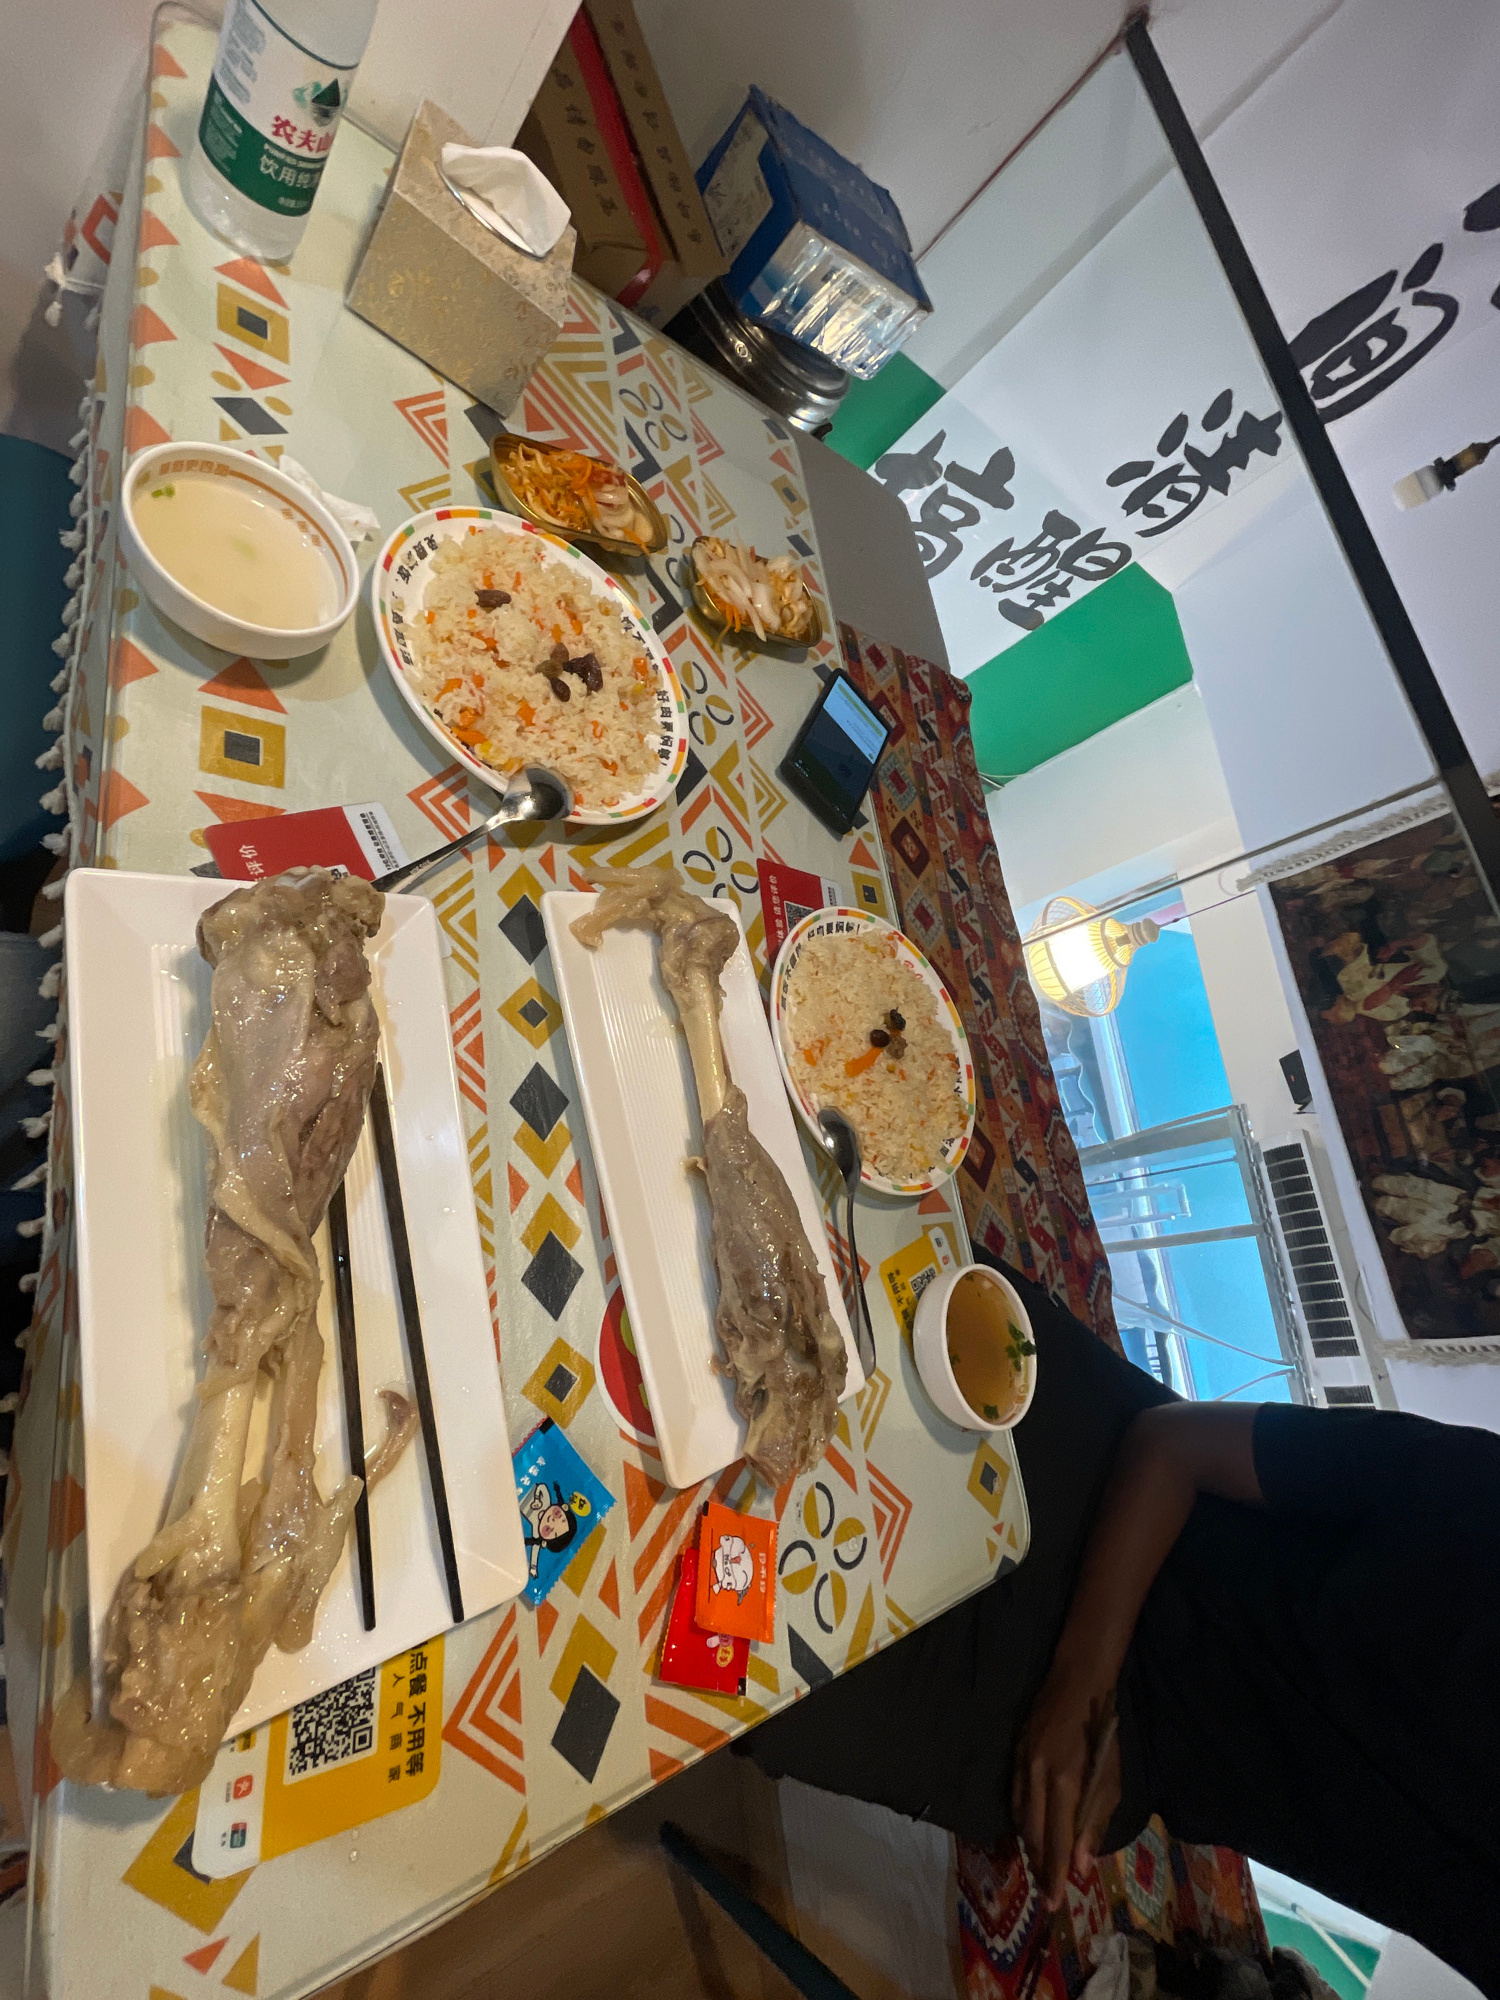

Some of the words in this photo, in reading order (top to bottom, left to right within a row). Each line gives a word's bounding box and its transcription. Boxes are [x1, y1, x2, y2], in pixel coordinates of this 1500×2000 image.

[970, 183, 1500, 631] 间清醒
[239, 844, 267, 882] 评价
[405, 1702, 427, 1777] 不用等
